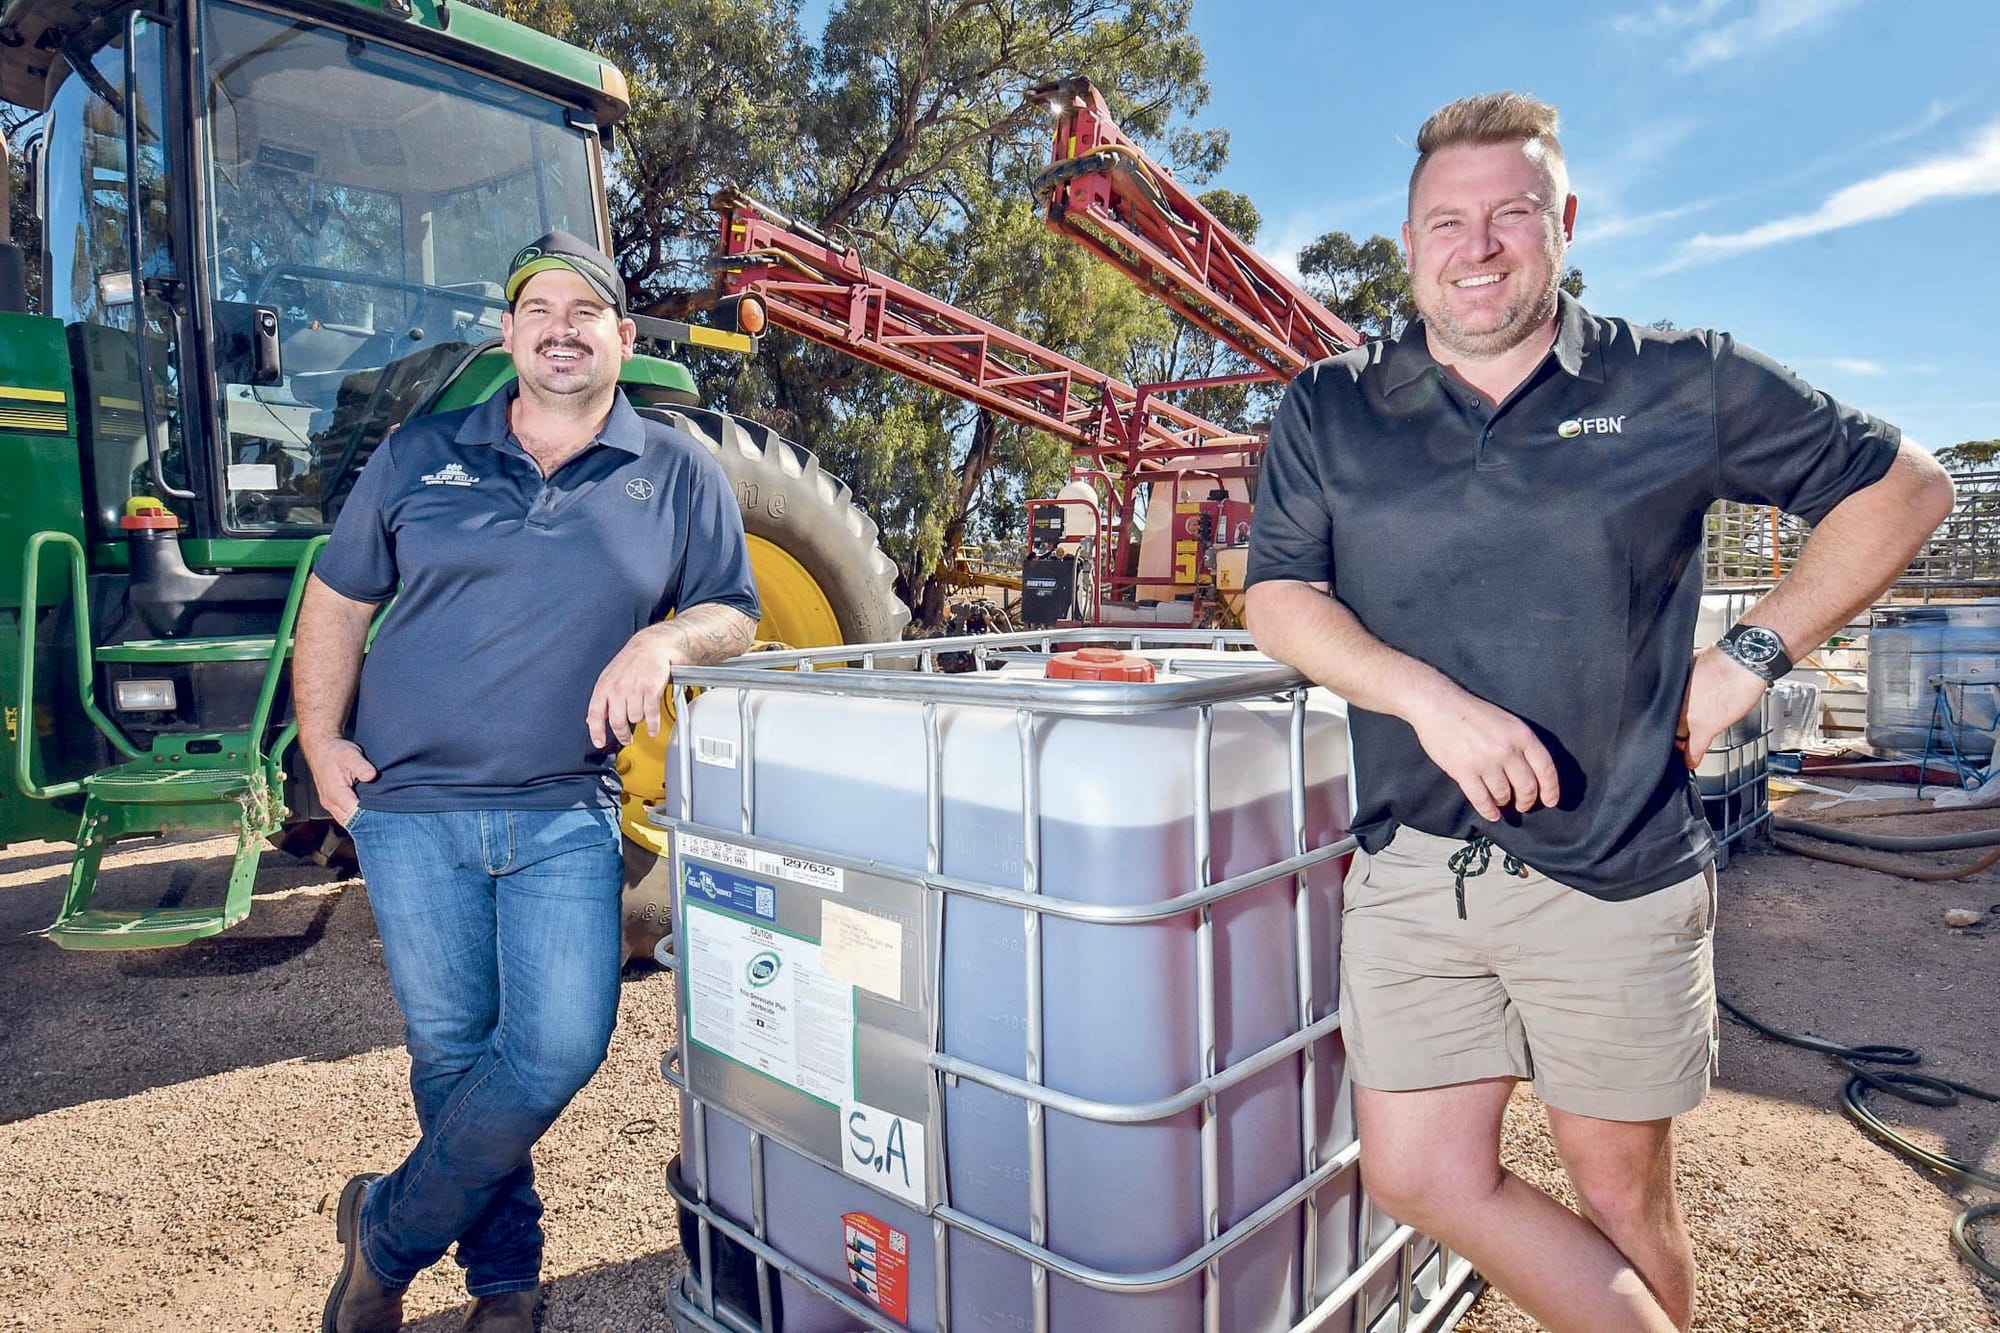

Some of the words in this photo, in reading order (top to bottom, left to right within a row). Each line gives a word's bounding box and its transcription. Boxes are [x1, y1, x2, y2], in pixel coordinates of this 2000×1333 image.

[1583, 417, 1622, 434] FBN
[782, 857, 836, 877] 1297635
[750, 926, 774, 941] CAUTION
